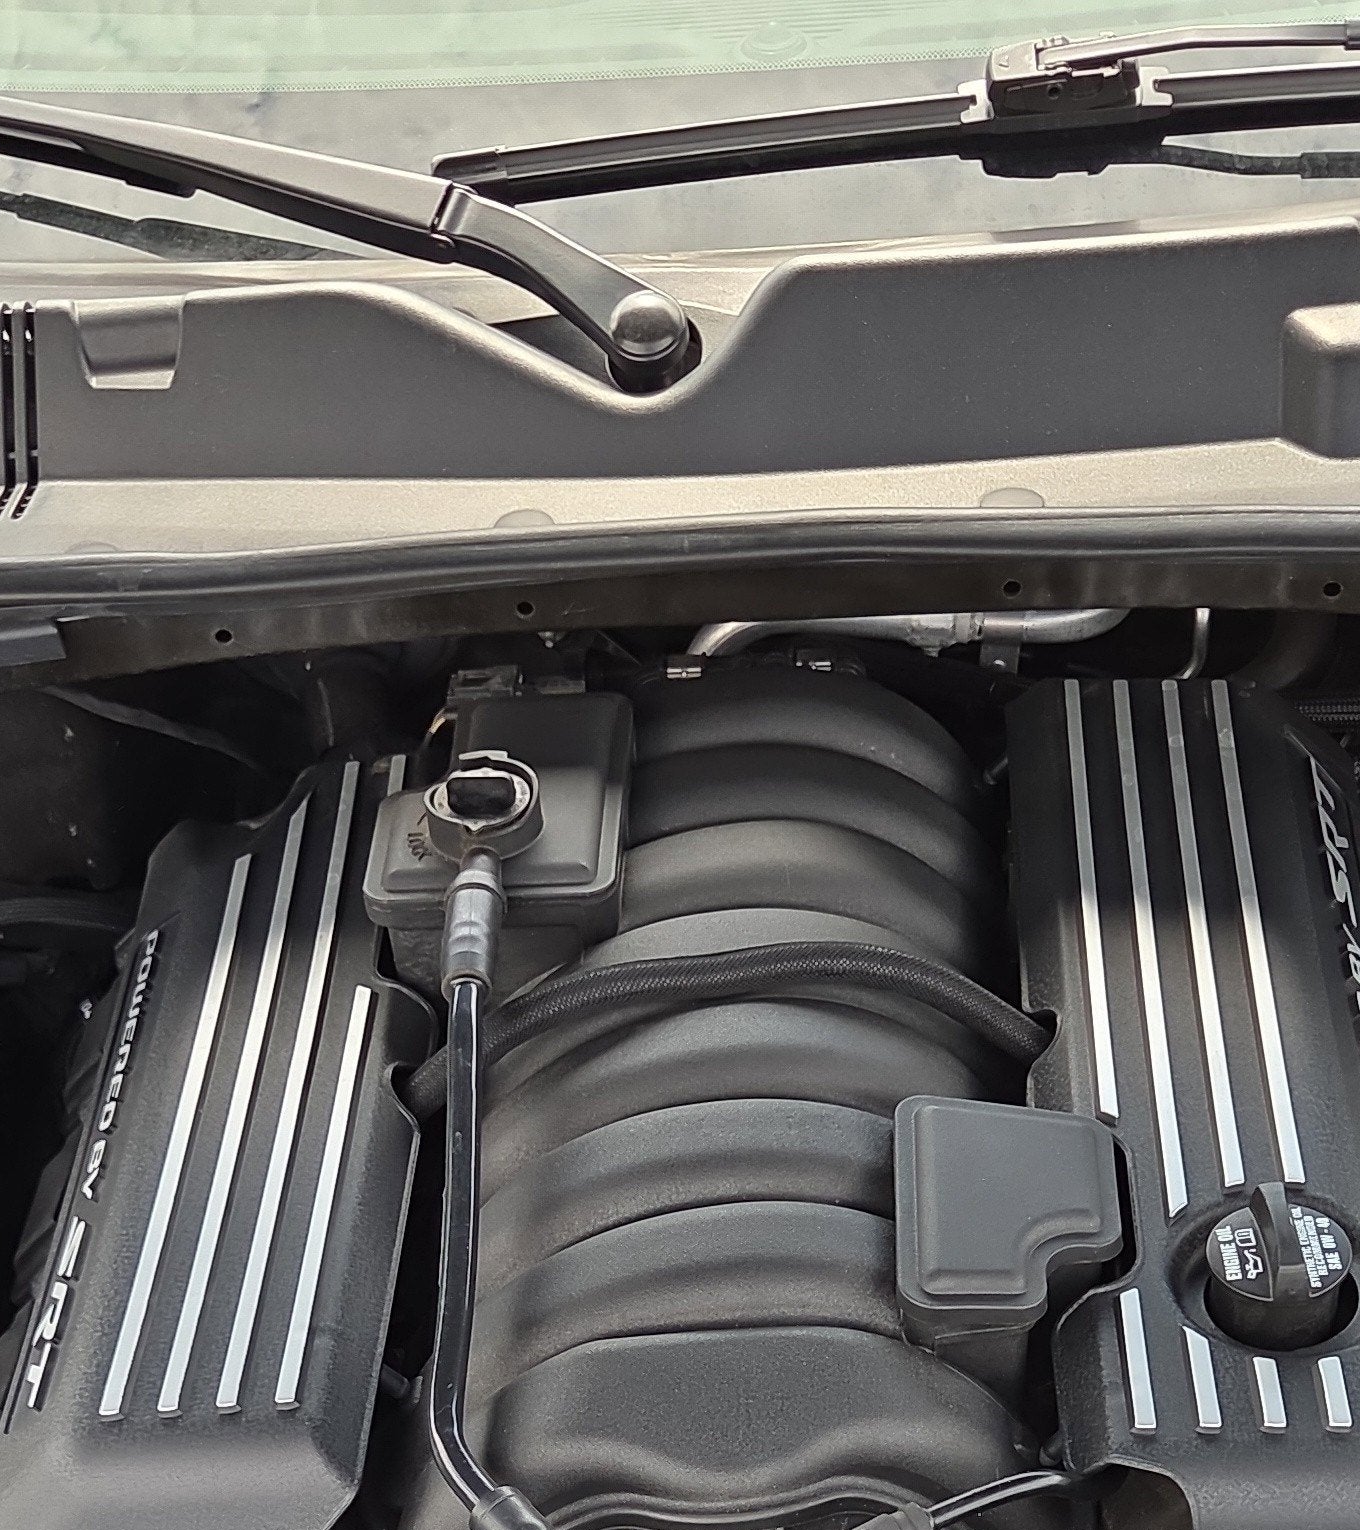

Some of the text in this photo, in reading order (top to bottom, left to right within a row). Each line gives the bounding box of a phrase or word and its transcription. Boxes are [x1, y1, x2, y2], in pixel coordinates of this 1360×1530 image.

[1309, 755, 1357, 929] SRT
[27, 929, 158, 1408] POWERED BY SRT
[1214, 1225, 1243, 1281] ENGINE OIL
